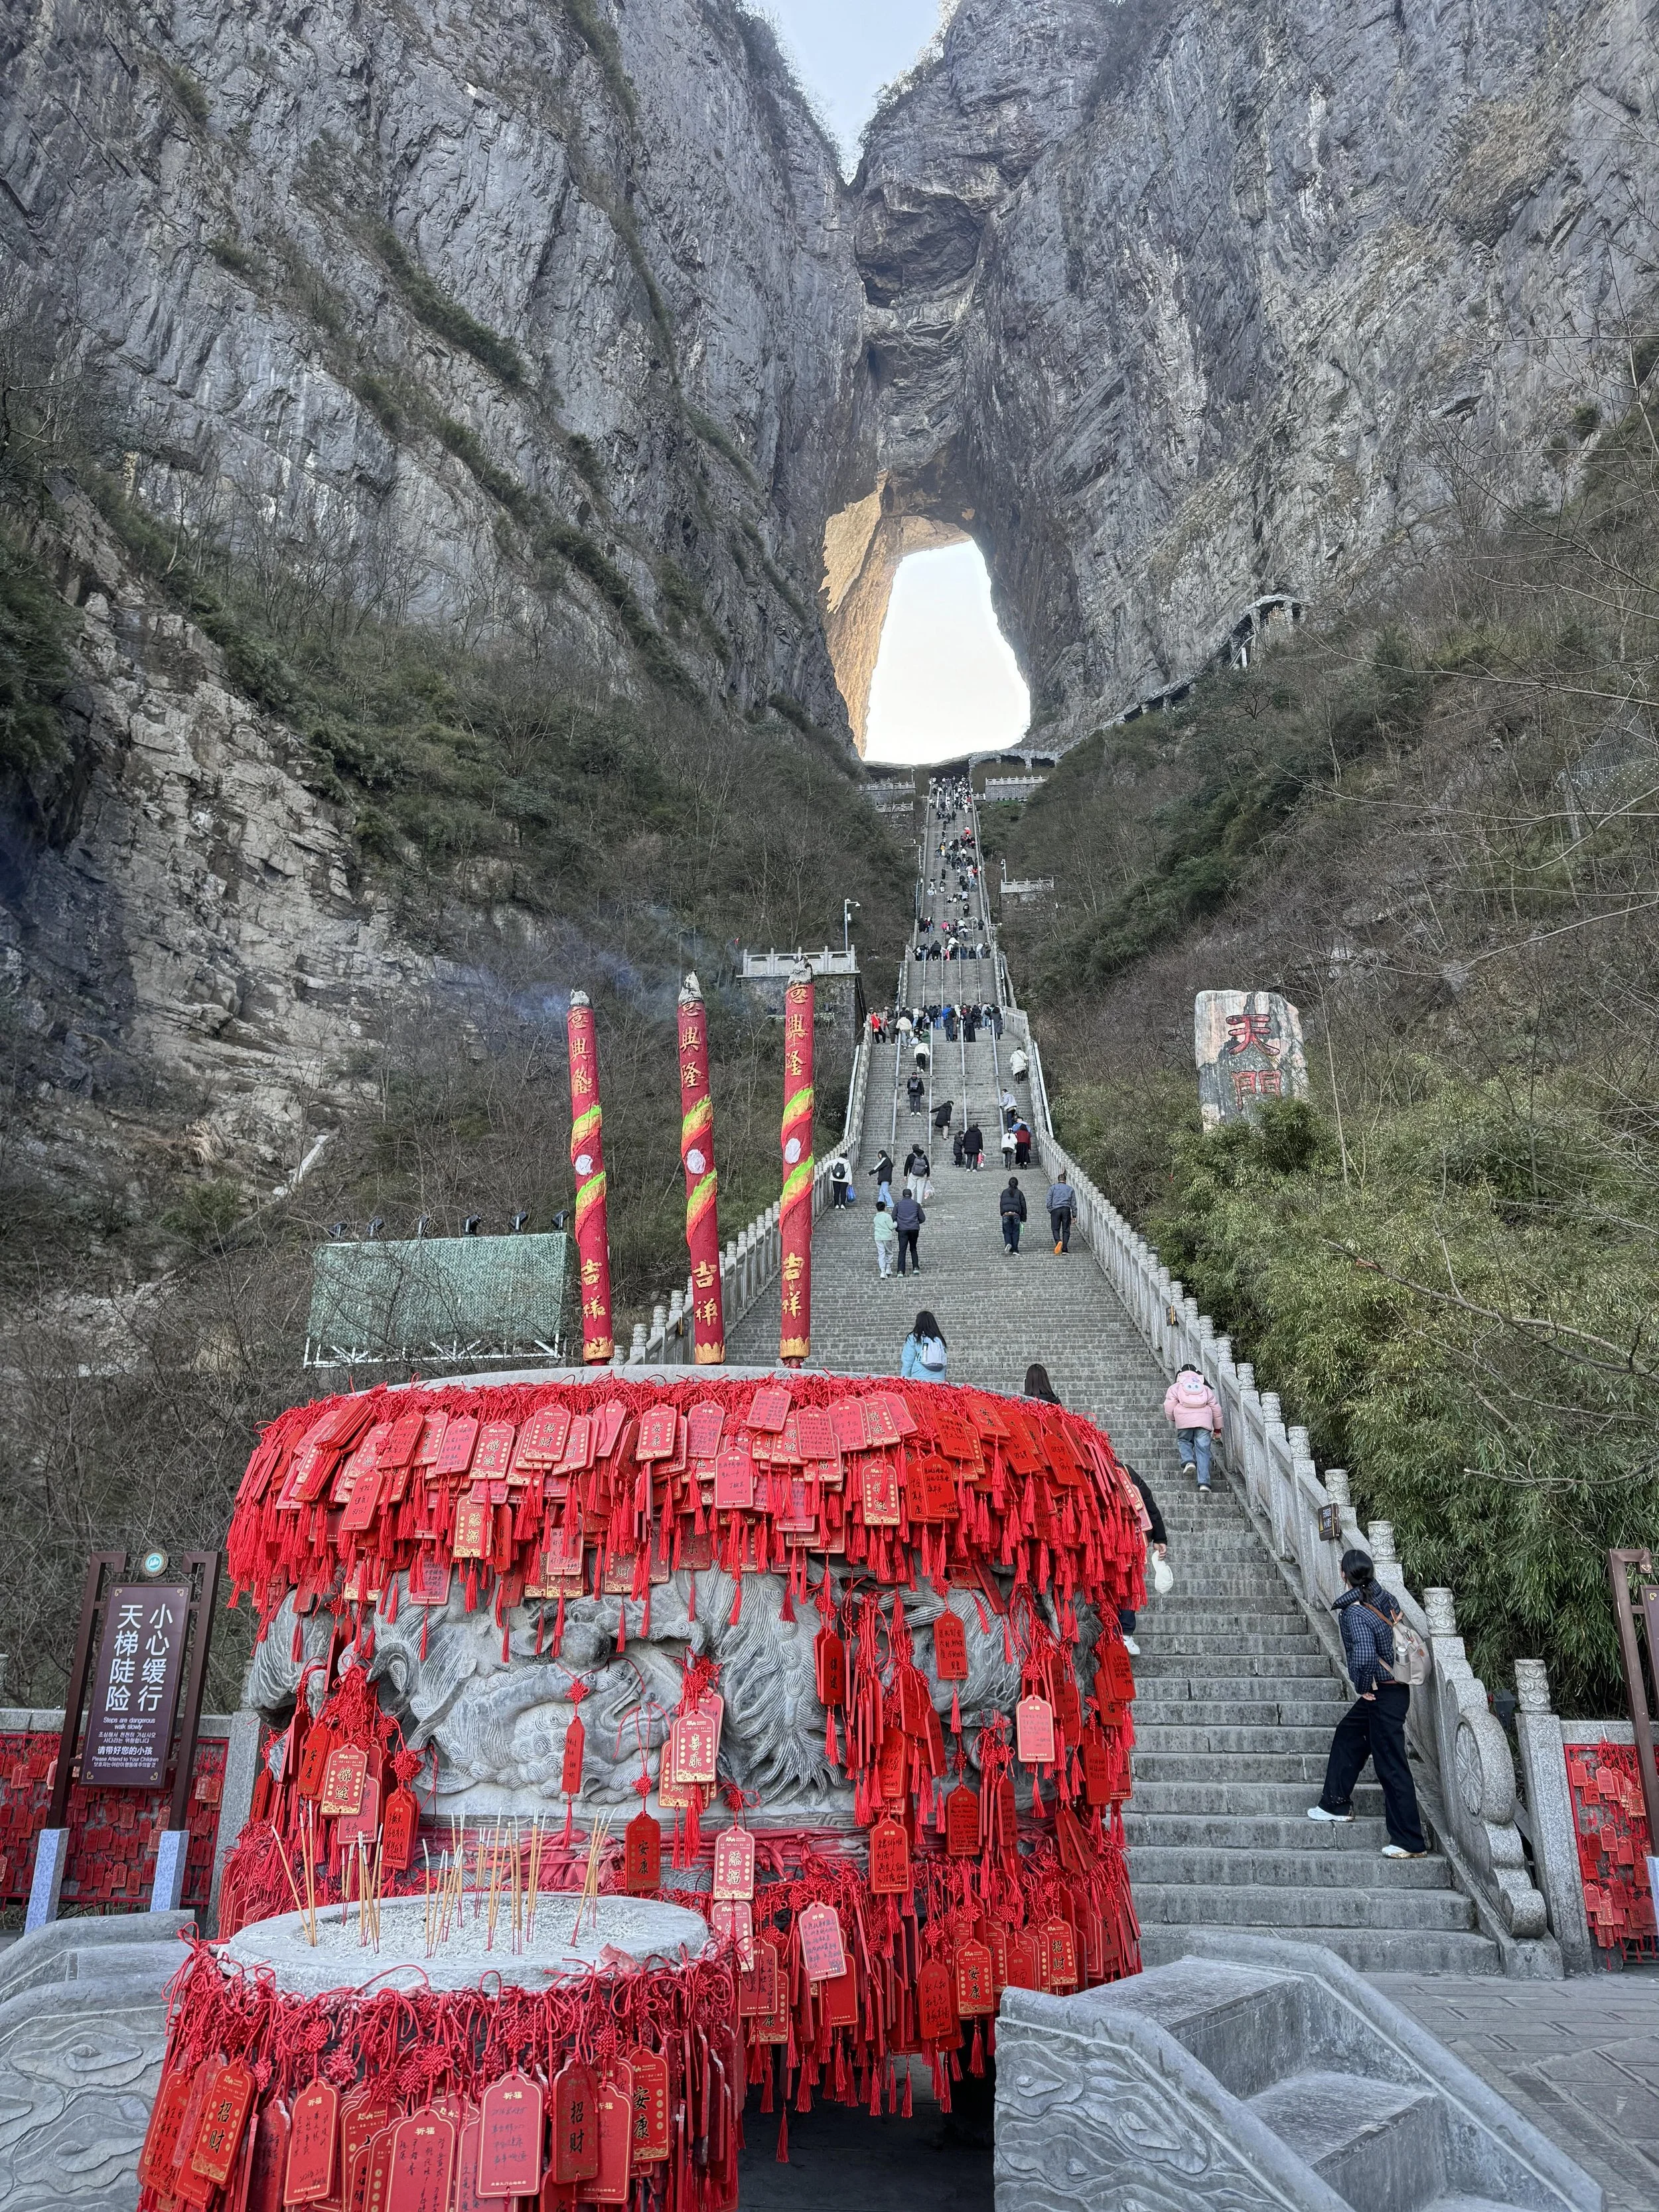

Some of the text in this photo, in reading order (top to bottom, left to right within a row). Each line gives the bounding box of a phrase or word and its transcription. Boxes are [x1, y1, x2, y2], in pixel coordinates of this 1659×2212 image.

[581, 1258, 607, 1322] 吉祥
[692, 1260, 719, 1327] 吉祥
[782, 1252, 805, 1320] 吉祥
[540, 1423, 556, 1448] 招财
[649, 1422, 663, 1447] 安康
[466, 1512, 481, 1544] 添福
[105, 1605, 143, 1712] 天梯陡险
[137, 1603, 173, 1712] 小心缓行
[98, 1745, 153, 1755] 请带好您的小孩
[688, 1733, 702, 1769] 喜乐
[334, 1767, 353, 1801] 锦途
[638, 1839, 650, 1876] 安康
[726, 1851, 742, 1885] 添福
[1052, 1939, 1066, 1971] 招财
[968, 1964, 981, 2000] 安康
[307, 2096, 323, 2108] 祈福
[503, 2091, 523, 2100] 祈福
[633, 2087, 651, 2140] 安康
[208, 2099, 233, 2155] 招财
[415, 2126, 435, 2136] 祈福
[569, 2101, 585, 2154] 招财
